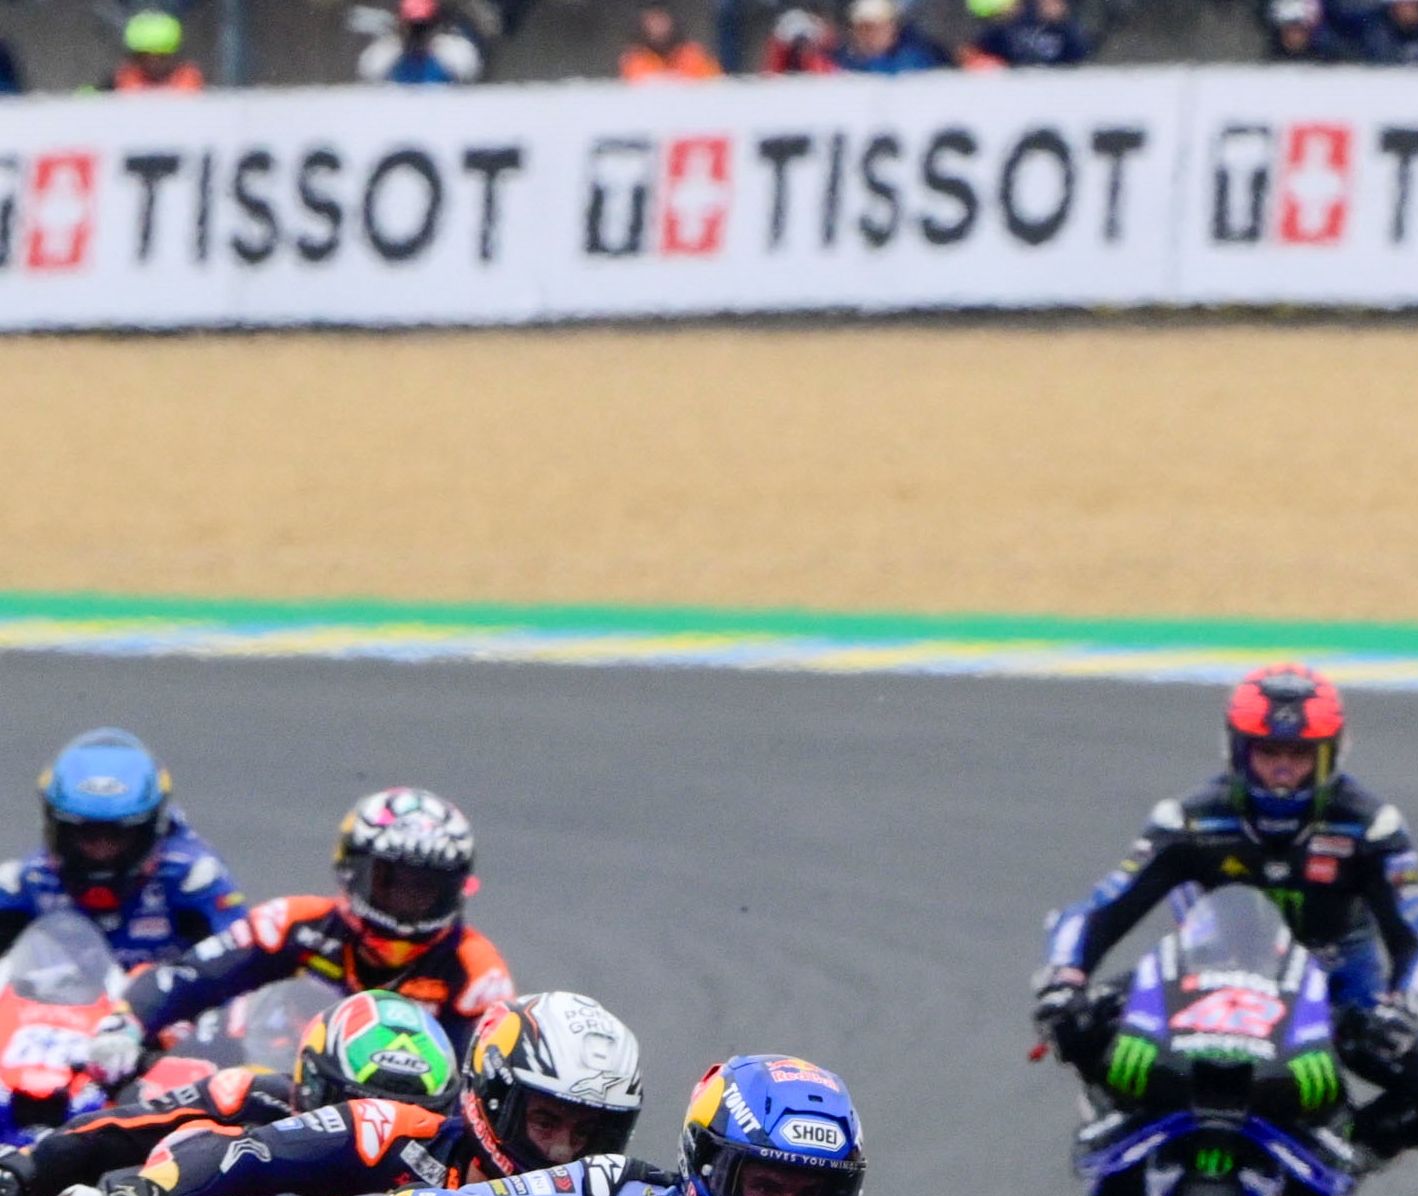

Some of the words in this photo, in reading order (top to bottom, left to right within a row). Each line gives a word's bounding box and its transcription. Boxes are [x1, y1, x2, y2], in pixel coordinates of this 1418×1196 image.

[124, 148, 523, 265] TISSOT
[759, 127, 1148, 253] TISSOT
[760, 1149, 796, 1162] GIVES
[802, 1155, 826, 1167] YOU
[792, 1124, 838, 1145] SHOEI
